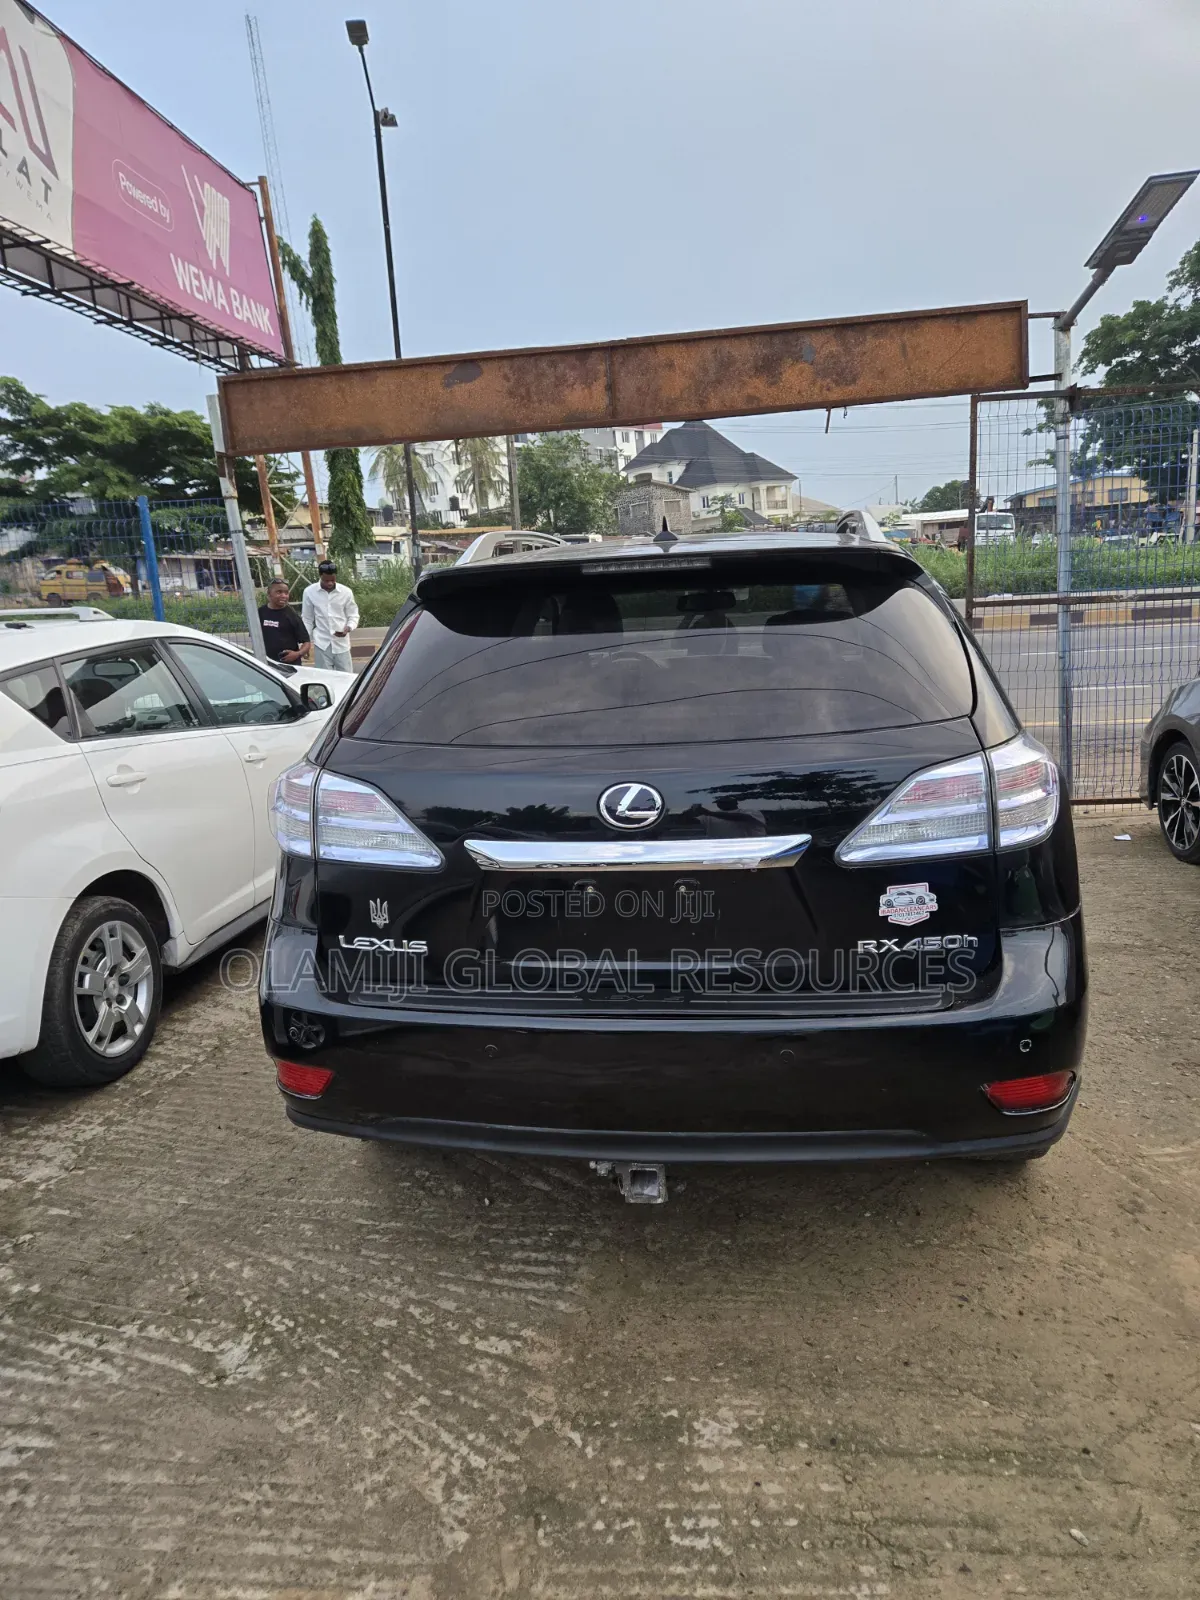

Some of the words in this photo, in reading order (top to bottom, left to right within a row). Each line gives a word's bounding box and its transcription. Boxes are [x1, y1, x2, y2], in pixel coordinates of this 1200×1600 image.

[118, 172, 159, 212] Powered
[159, 202, 172, 223] by
[169, 253, 231, 316] WEMA
[230, 290, 275, 337] BANK
[338, 935, 429, 954] LEXUS
